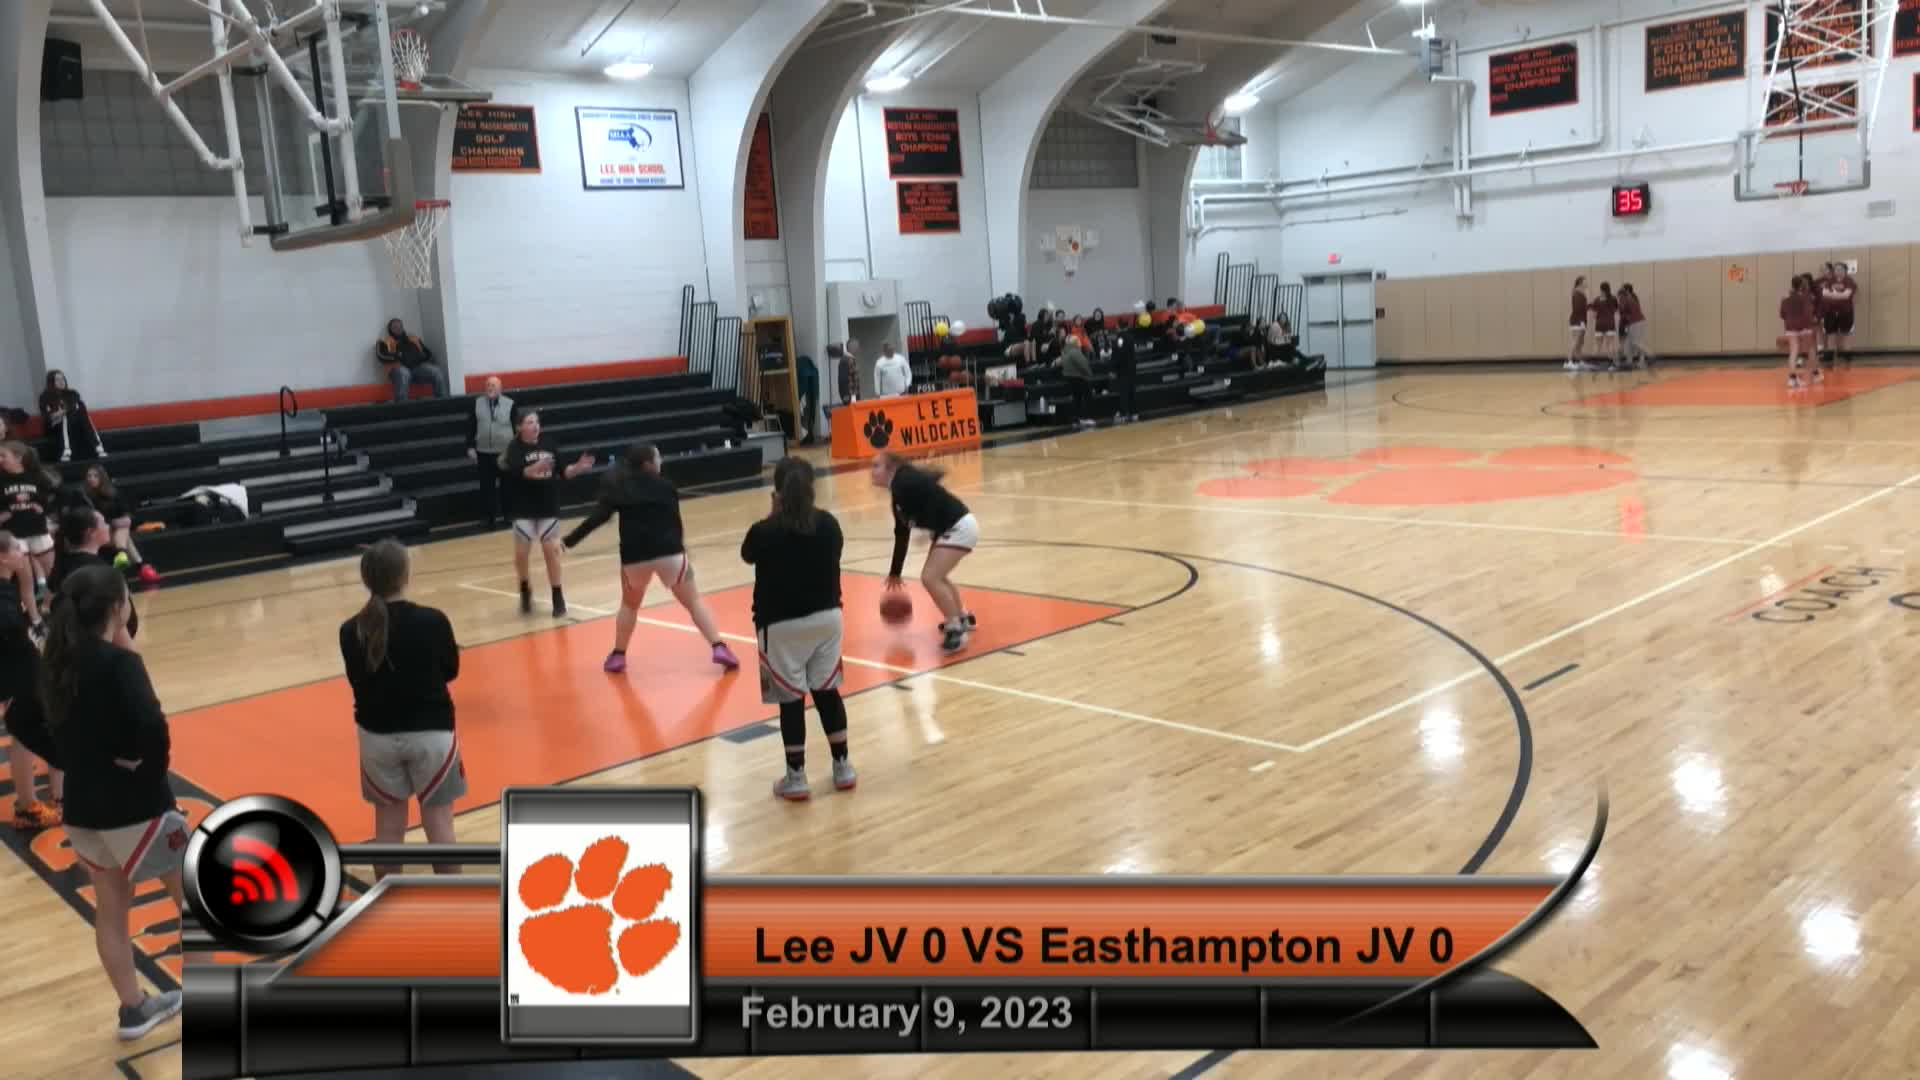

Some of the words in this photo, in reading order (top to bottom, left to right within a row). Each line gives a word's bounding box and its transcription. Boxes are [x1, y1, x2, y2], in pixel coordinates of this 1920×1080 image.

[1653, 32, 1738, 57] FOOTBALL
[1653, 50, 1697, 67] SUPER
[1702, 43, 1738, 60] BOWL
[1654, 54, 1738, 77] CHAMPIONS
[1504, 75, 1561, 92] CHAMPIONS
[475, 133, 506, 145] GOLF
[460, 145, 525, 158] CHAMPIONS
[600, 163, 615, 175] LEE
[638, 163, 667, 175] SCHOOL
[1619, 188, 1643, 212] 35
[917, 398, 955, 421] LEE
[900, 417, 977, 447] WILDCATS
[1751, 565, 1904, 624] COACH
